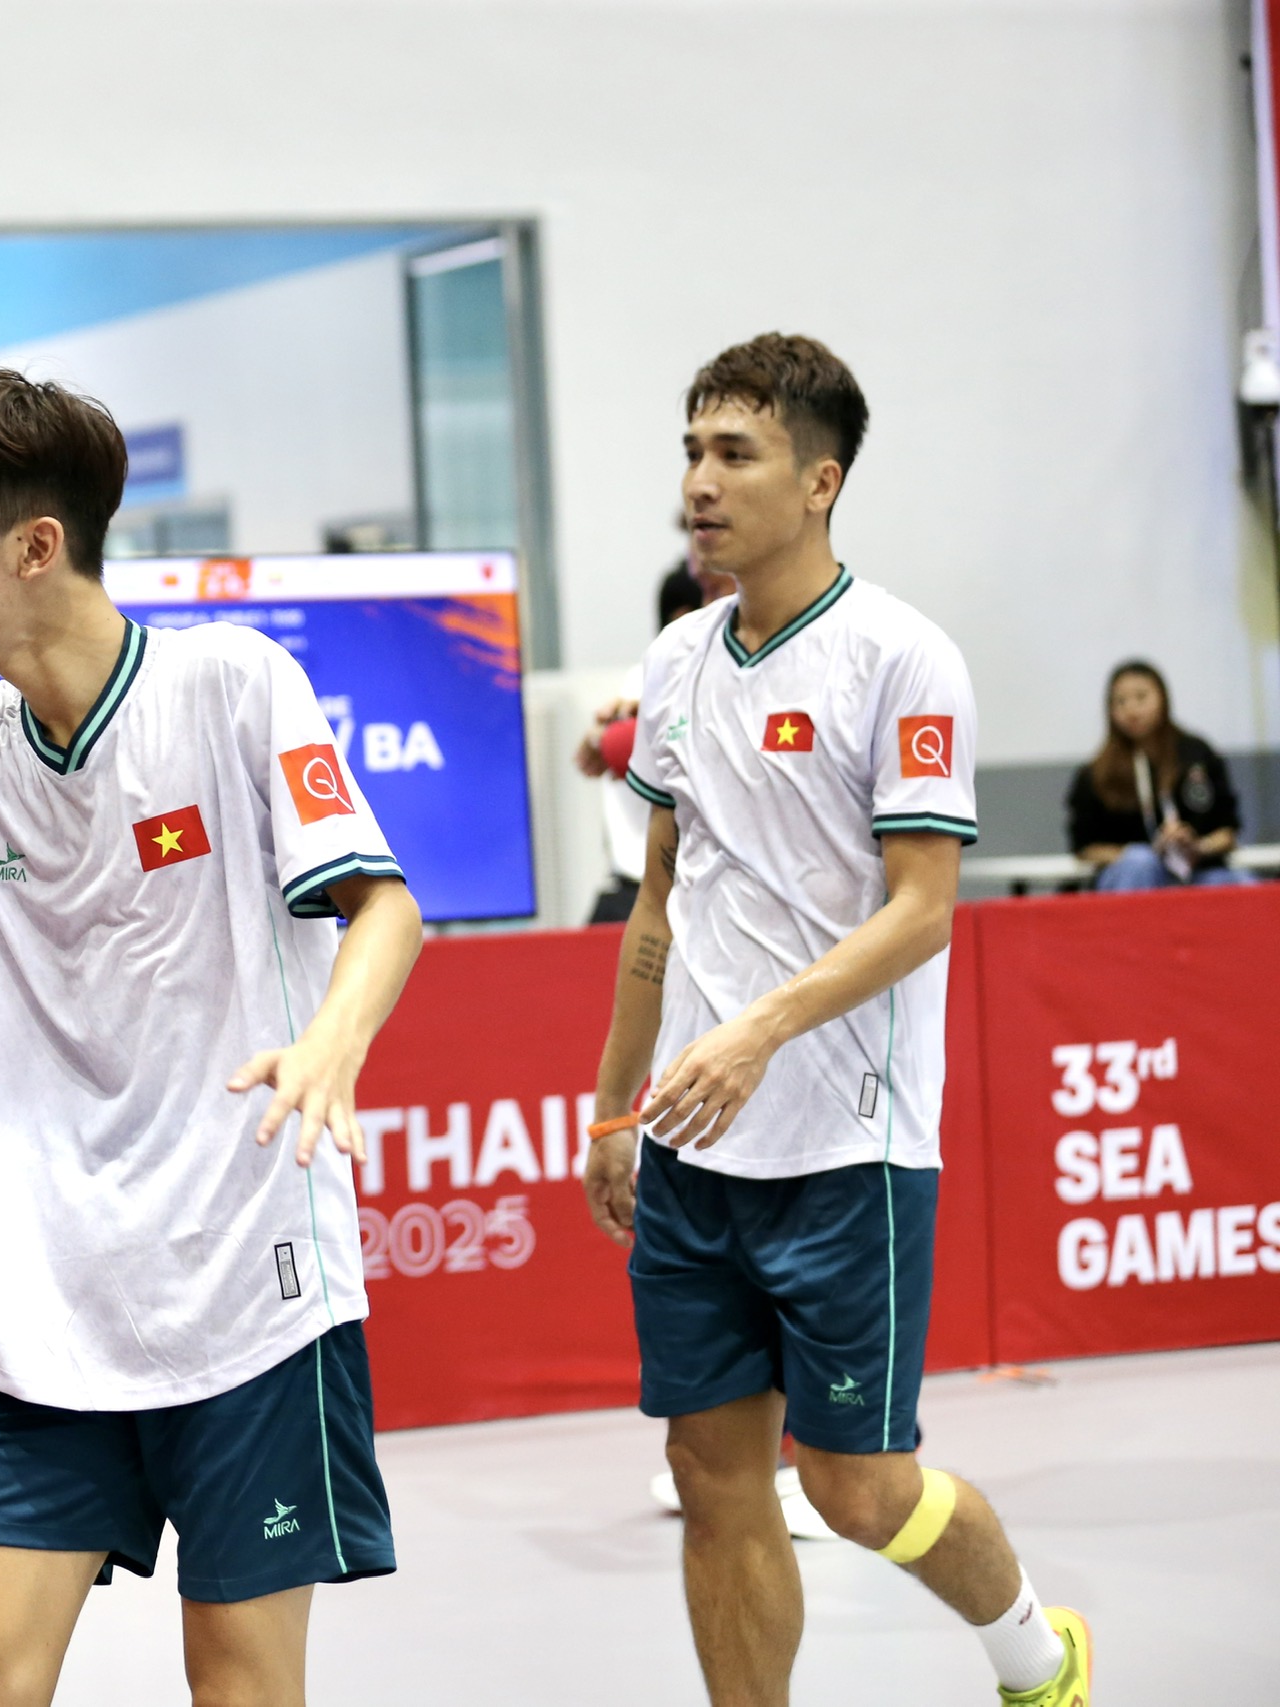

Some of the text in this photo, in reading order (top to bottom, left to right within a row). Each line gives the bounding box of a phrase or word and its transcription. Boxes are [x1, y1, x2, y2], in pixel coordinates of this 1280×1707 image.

[1051, 1037, 1178, 1117] 33rd
[1054, 1123, 1193, 1205] SEA
[357, 1195, 536, 1279] 2025
[263, 1518, 301, 1540] MIRA
